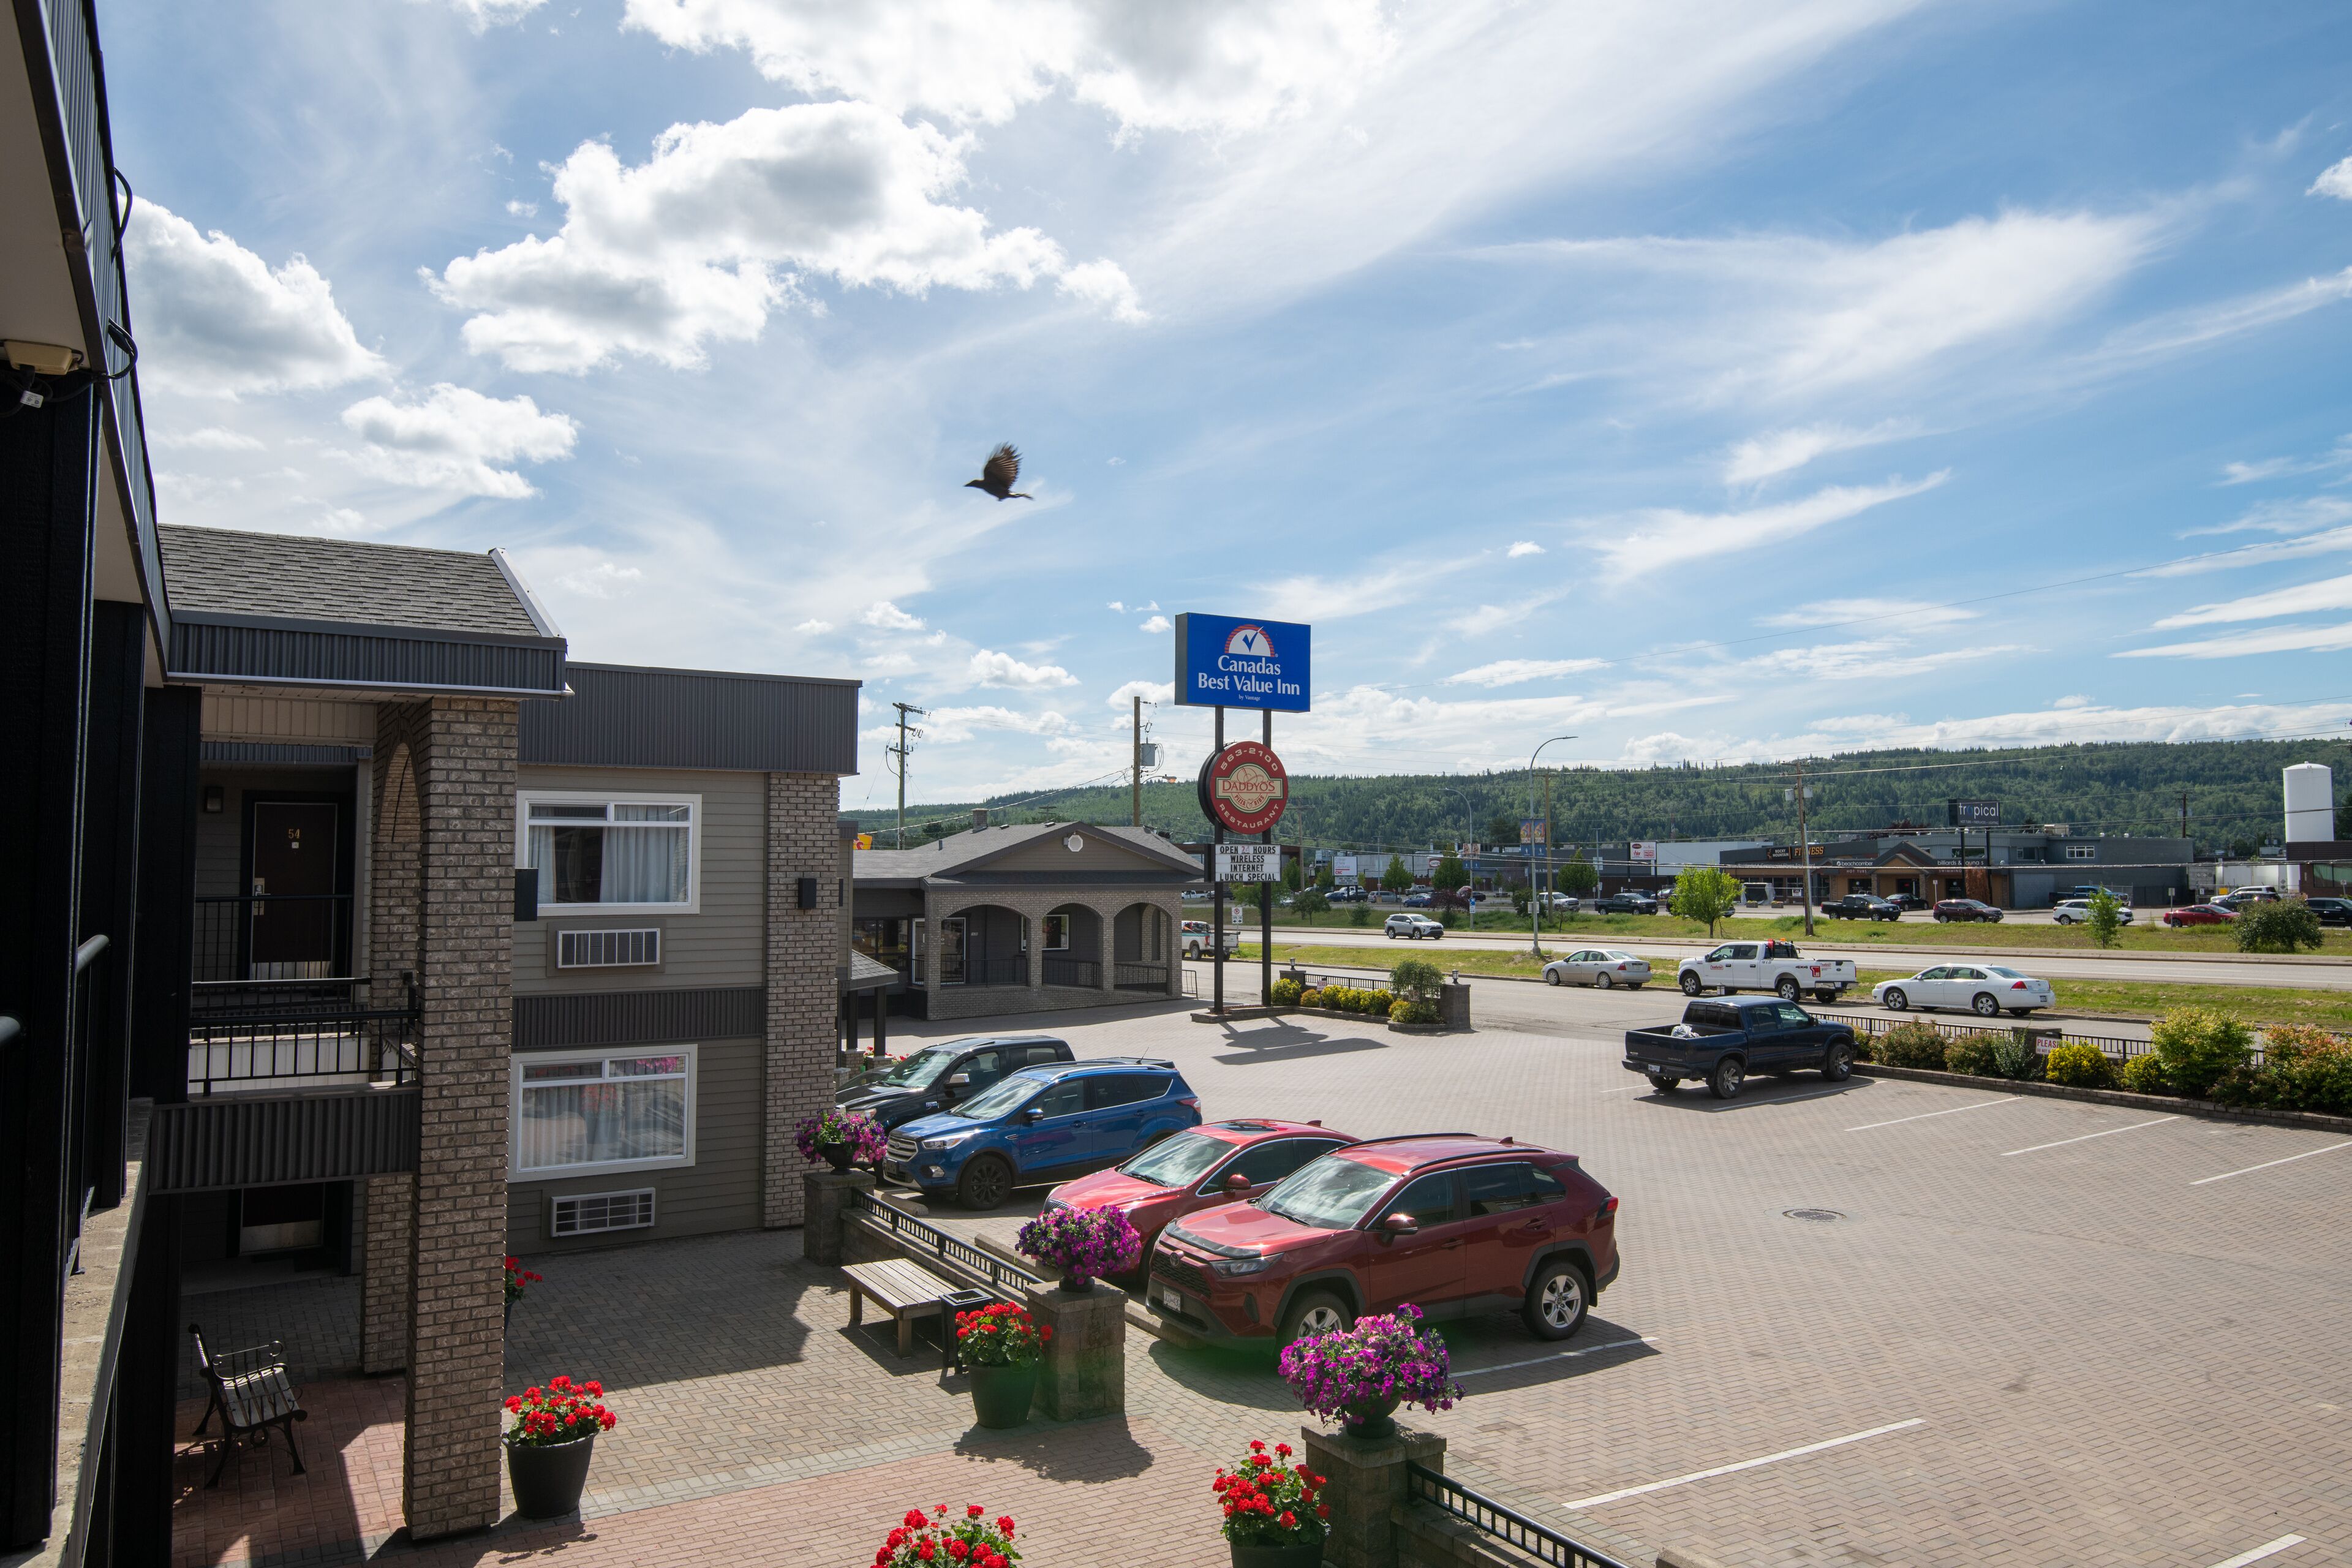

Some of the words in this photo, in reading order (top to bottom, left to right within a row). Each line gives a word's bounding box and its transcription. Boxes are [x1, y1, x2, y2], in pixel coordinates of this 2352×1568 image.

[1218, 655, 1281, 675] Canadas
[1198, 673, 1229, 690] Best
[1234, 675, 1273, 693] Value
[1277, 679, 1300, 695] Inn
[1221, 747, 1278, 771] 563-2100
[1234, 794, 1246, 807] PIZZA
[1254, 795, 1265, 806] RIBS
[1959, 802, 1999, 819] tropical
[1219, 803, 1279, 828] RESTAURANT
[288, 829, 300, 839] 54
